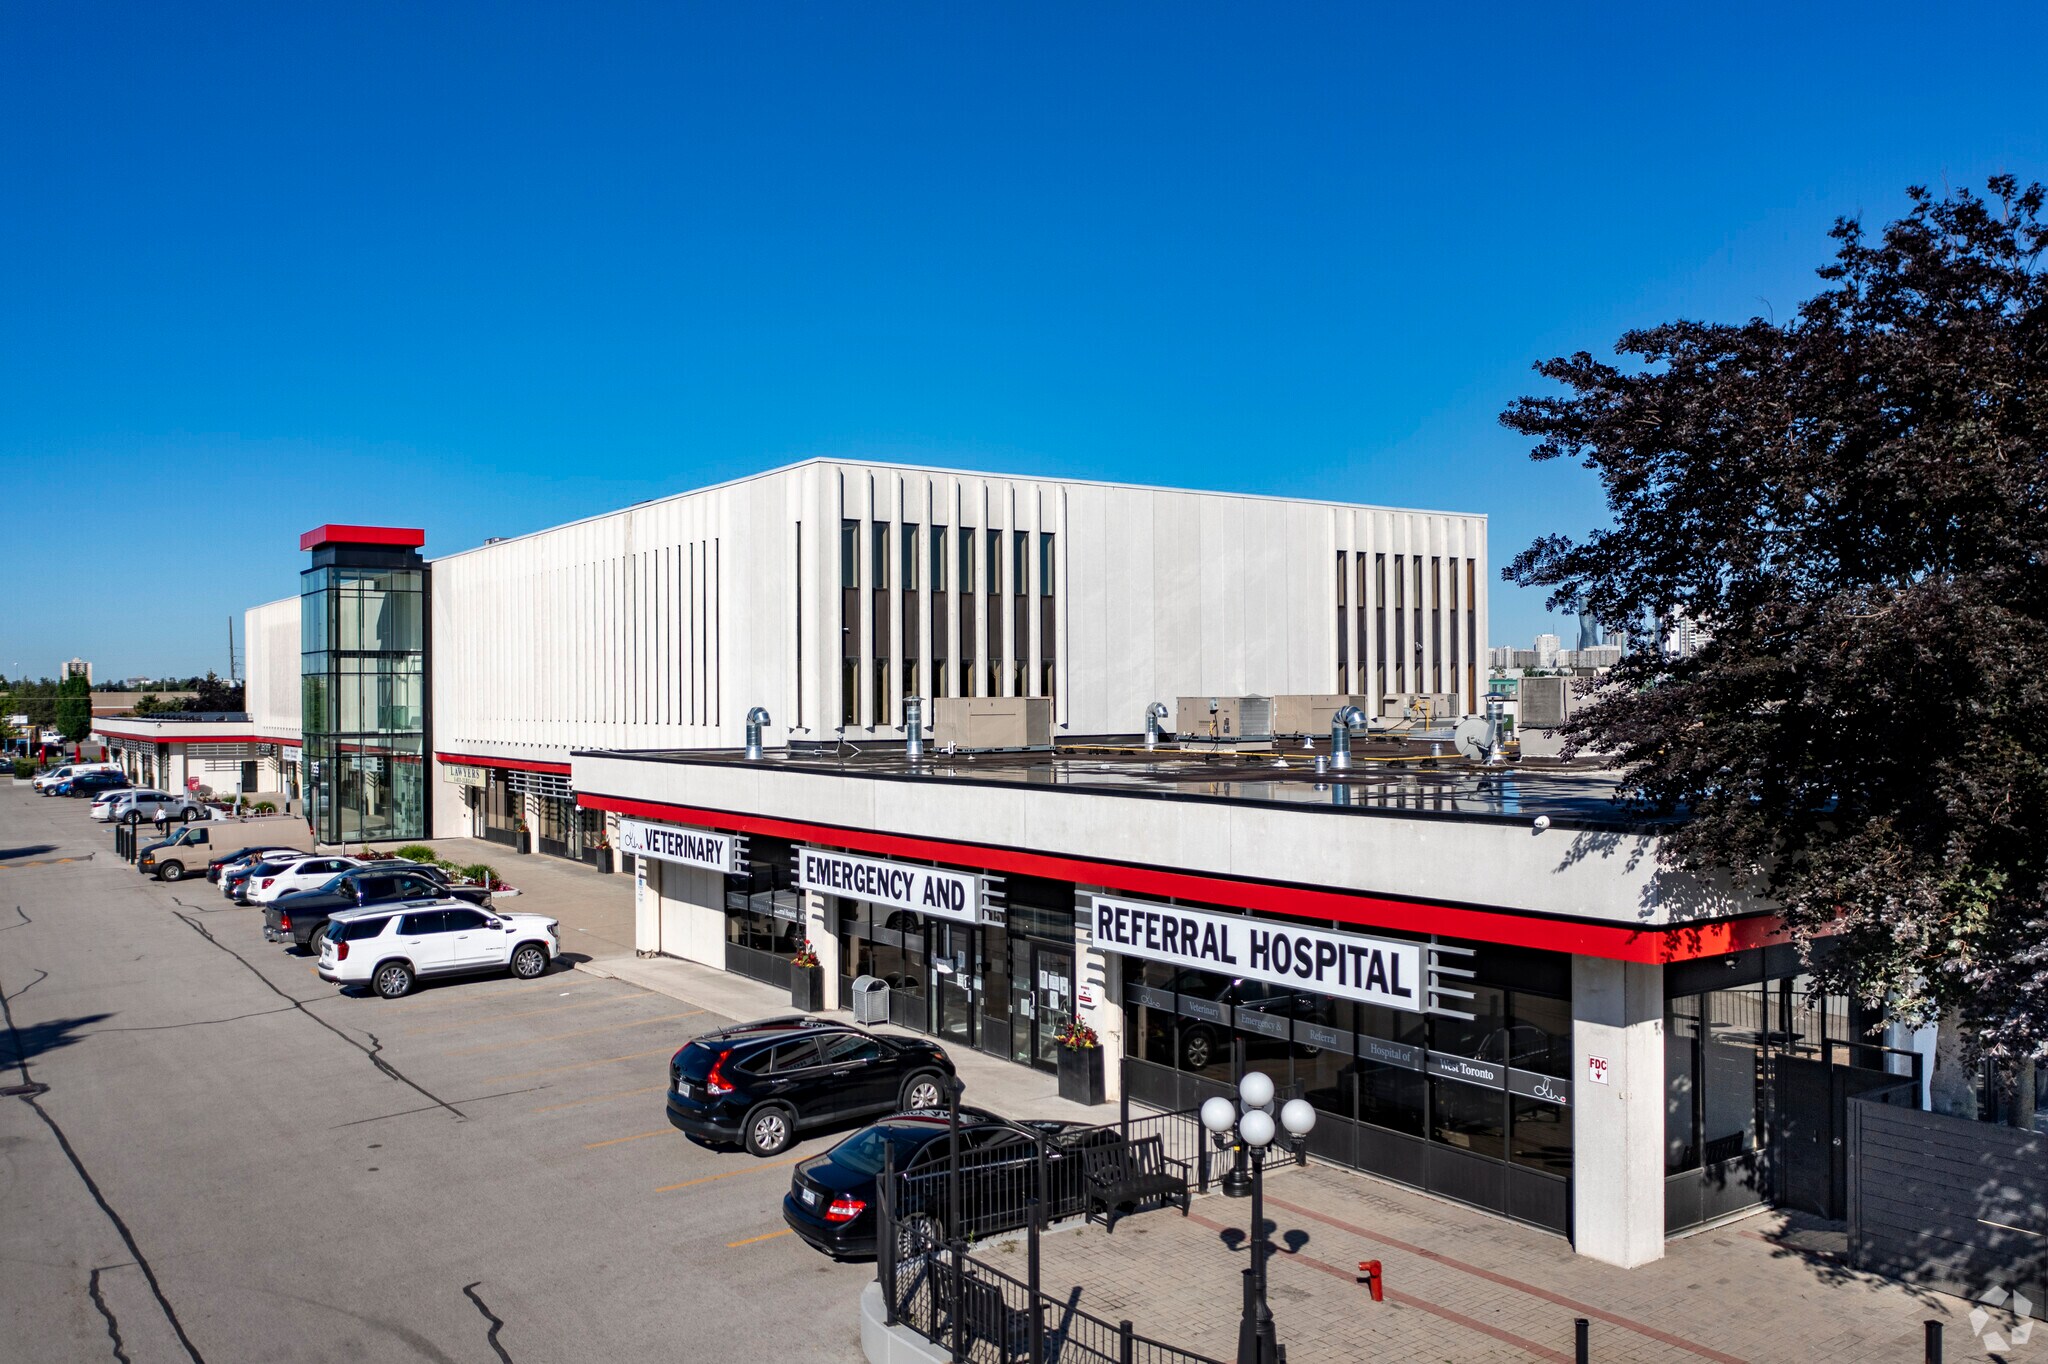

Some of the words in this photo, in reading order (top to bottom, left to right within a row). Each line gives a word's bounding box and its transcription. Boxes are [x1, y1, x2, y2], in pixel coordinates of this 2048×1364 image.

[450, 766, 480, 779] LAWYERS
[645, 828, 724, 864] VETERINARY
[806, 856, 915, 902] EMERGENCY
[922, 876, 966, 911] AND
[1098, 904, 1237, 965] REFERRAL
[1250, 928, 1412, 998] HOSPITAL
[1189, 1001, 1219, 1018] Veterinary
[1241, 1013, 1275, 1032] Emergency
[1309, 1029, 1337, 1045] Referral
[1370, 1043, 1401, 1059] Hospital
[1402, 1051, 1411, 1062] of
[1440, 1058, 1459, 1073] West
[1460, 1062, 1494, 1081] Toronto
[1589, 1058, 1607, 1071] FDC
